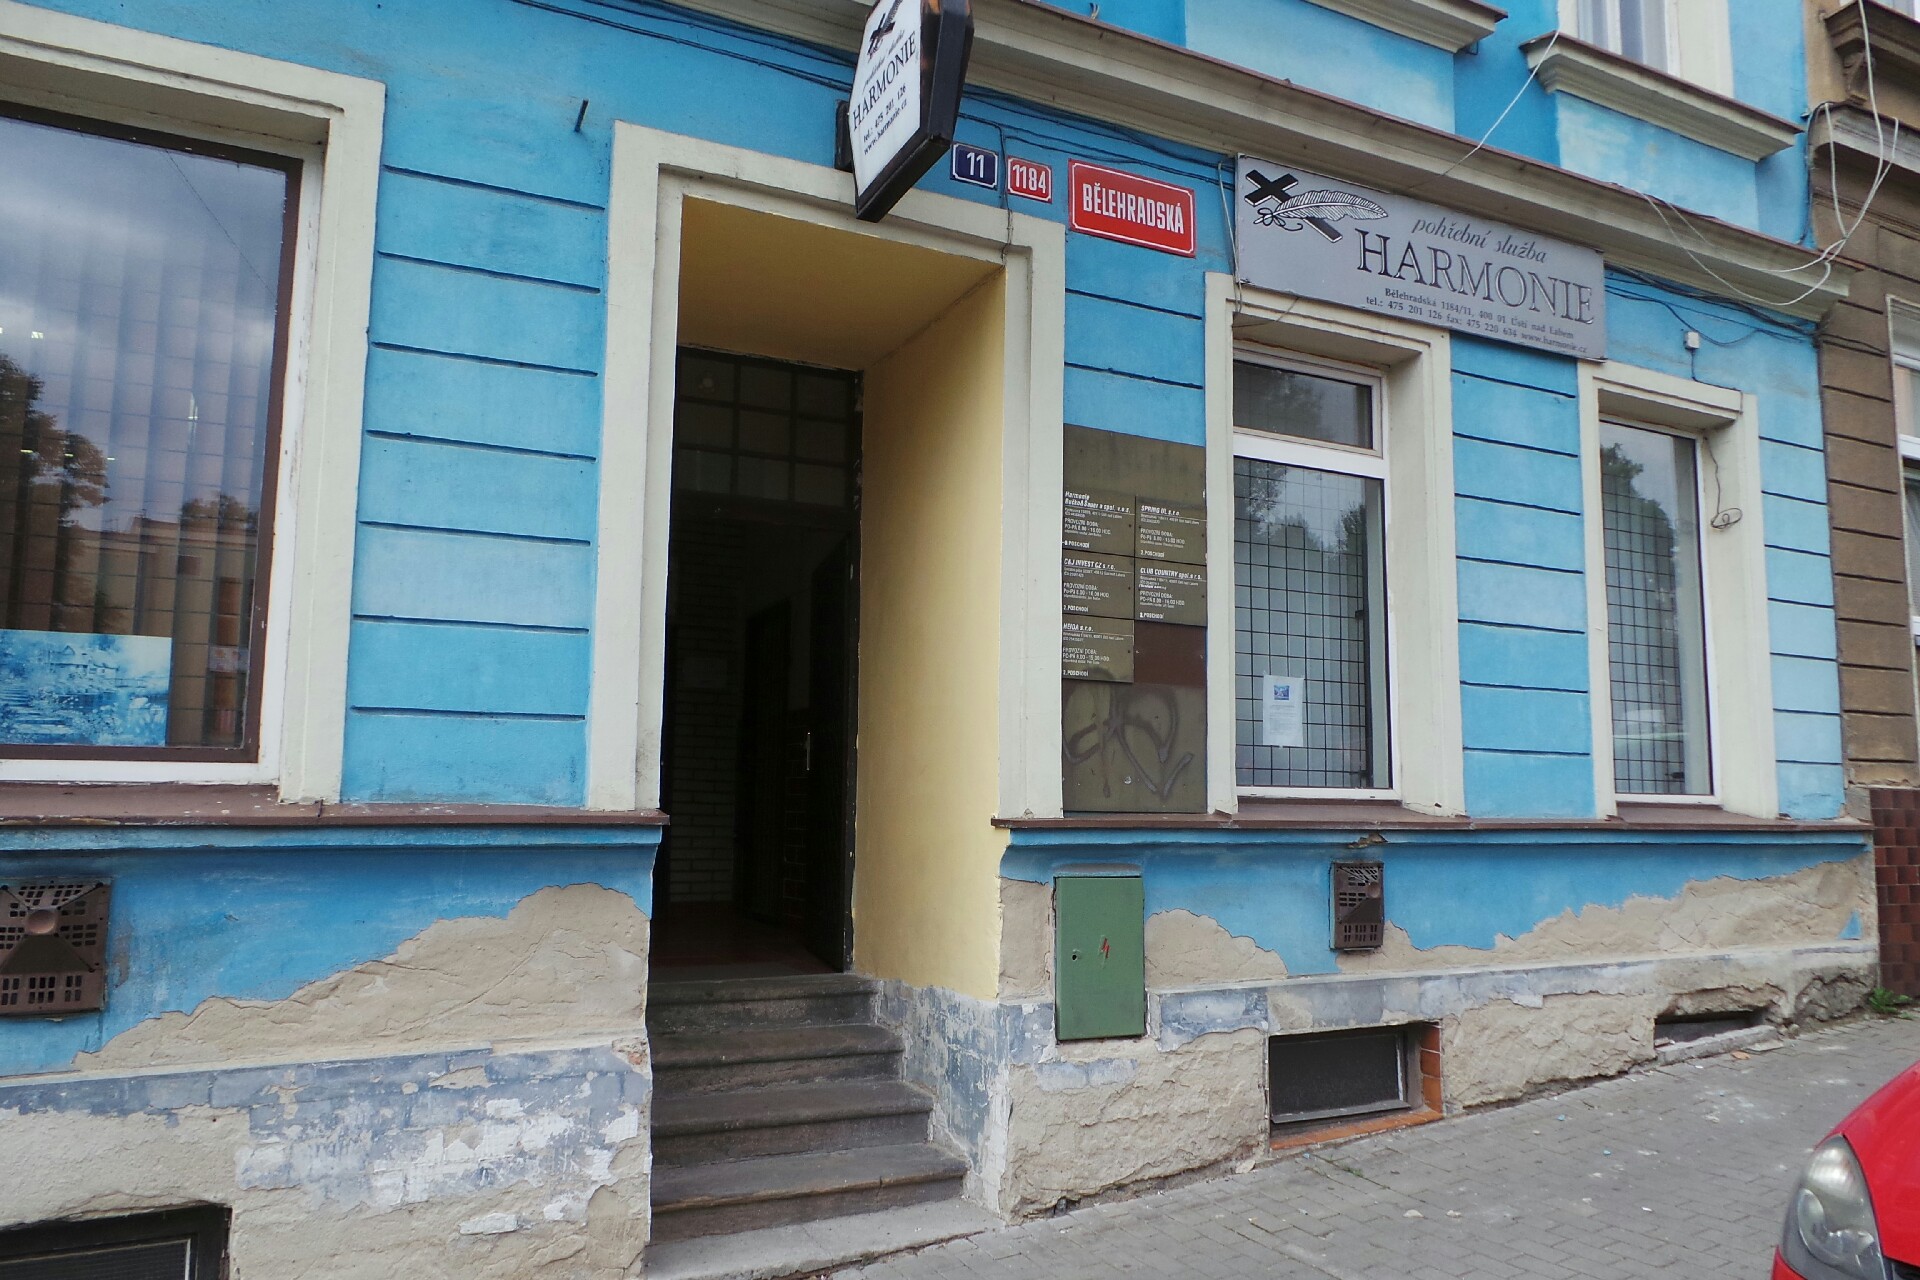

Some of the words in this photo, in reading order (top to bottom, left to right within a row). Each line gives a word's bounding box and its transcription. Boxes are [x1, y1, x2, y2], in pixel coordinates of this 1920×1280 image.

[853, 31, 917, 131] HARMONIE
[875, 111, 884, 130] 475
[897, 83, 907, 102] 126
[966, 152, 985, 179] 11
[1012, 164, 1046, 194] 1184
[1083, 183, 1184, 235] BĚLEHRADSKÁ
[1411, 216, 1490, 249] pohřební
[1495, 239, 1547, 264] služba
[1355, 228, 1594, 325] HARMONIE
[1366, 296, 1383, 307] tel.:
[1388, 301, 1404, 311] 475
[1409, 305, 1422, 315] 201
[1428, 309, 1442, 320] 126
[1467, 319, 1480, 329] 475
[1485, 323, 1499, 333] 220
[1503, 327, 1517, 337] 634
[1521, 333, 1587, 353] www.harmonie.cz
[1385, 288, 1437, 307] Bělehradská
[1532, 324, 1546, 333] nad
[1140, 567, 1154, 575] CLUB
